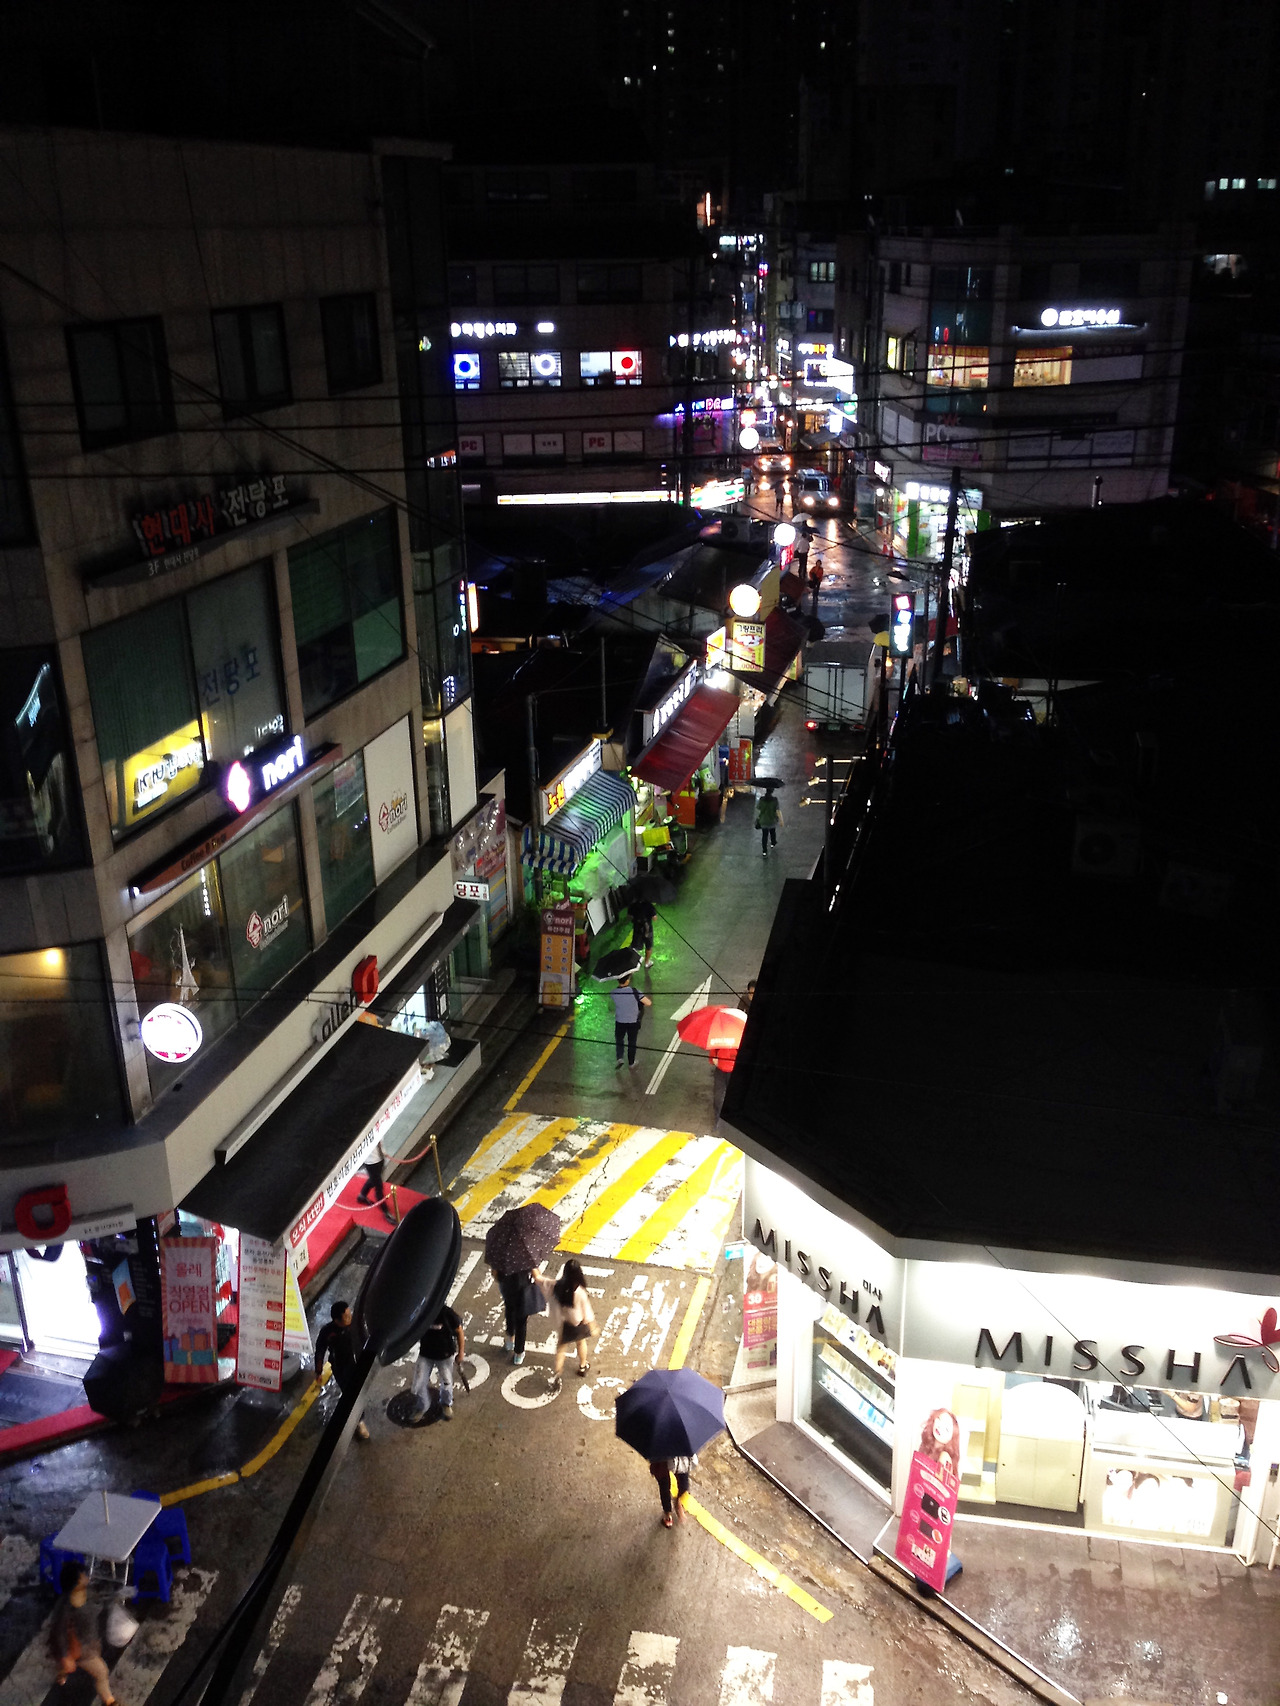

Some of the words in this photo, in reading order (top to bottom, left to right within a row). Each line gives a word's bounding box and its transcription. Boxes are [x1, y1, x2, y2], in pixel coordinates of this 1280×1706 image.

[461, 440, 478, 451] PC
[134, 494, 215, 557] 현대사
[223, 474, 289, 527] 전당포
[200, 646, 261, 707] 전당포
[262, 734, 304, 791] nori
[389, 792, 408, 824] nori
[263, 894, 289, 936] nori
[555, 916, 573, 926] nori
[177, 1262, 202, 1278] 올레
[754, 1218, 885, 1335] MISSHA
[169, 1299, 210, 1314] OPEN
[170, 1284, 209, 1301] 직영점
[863, 1280, 882, 1302] 미샤
[975, 1327, 1252, 1390] MISSHA
